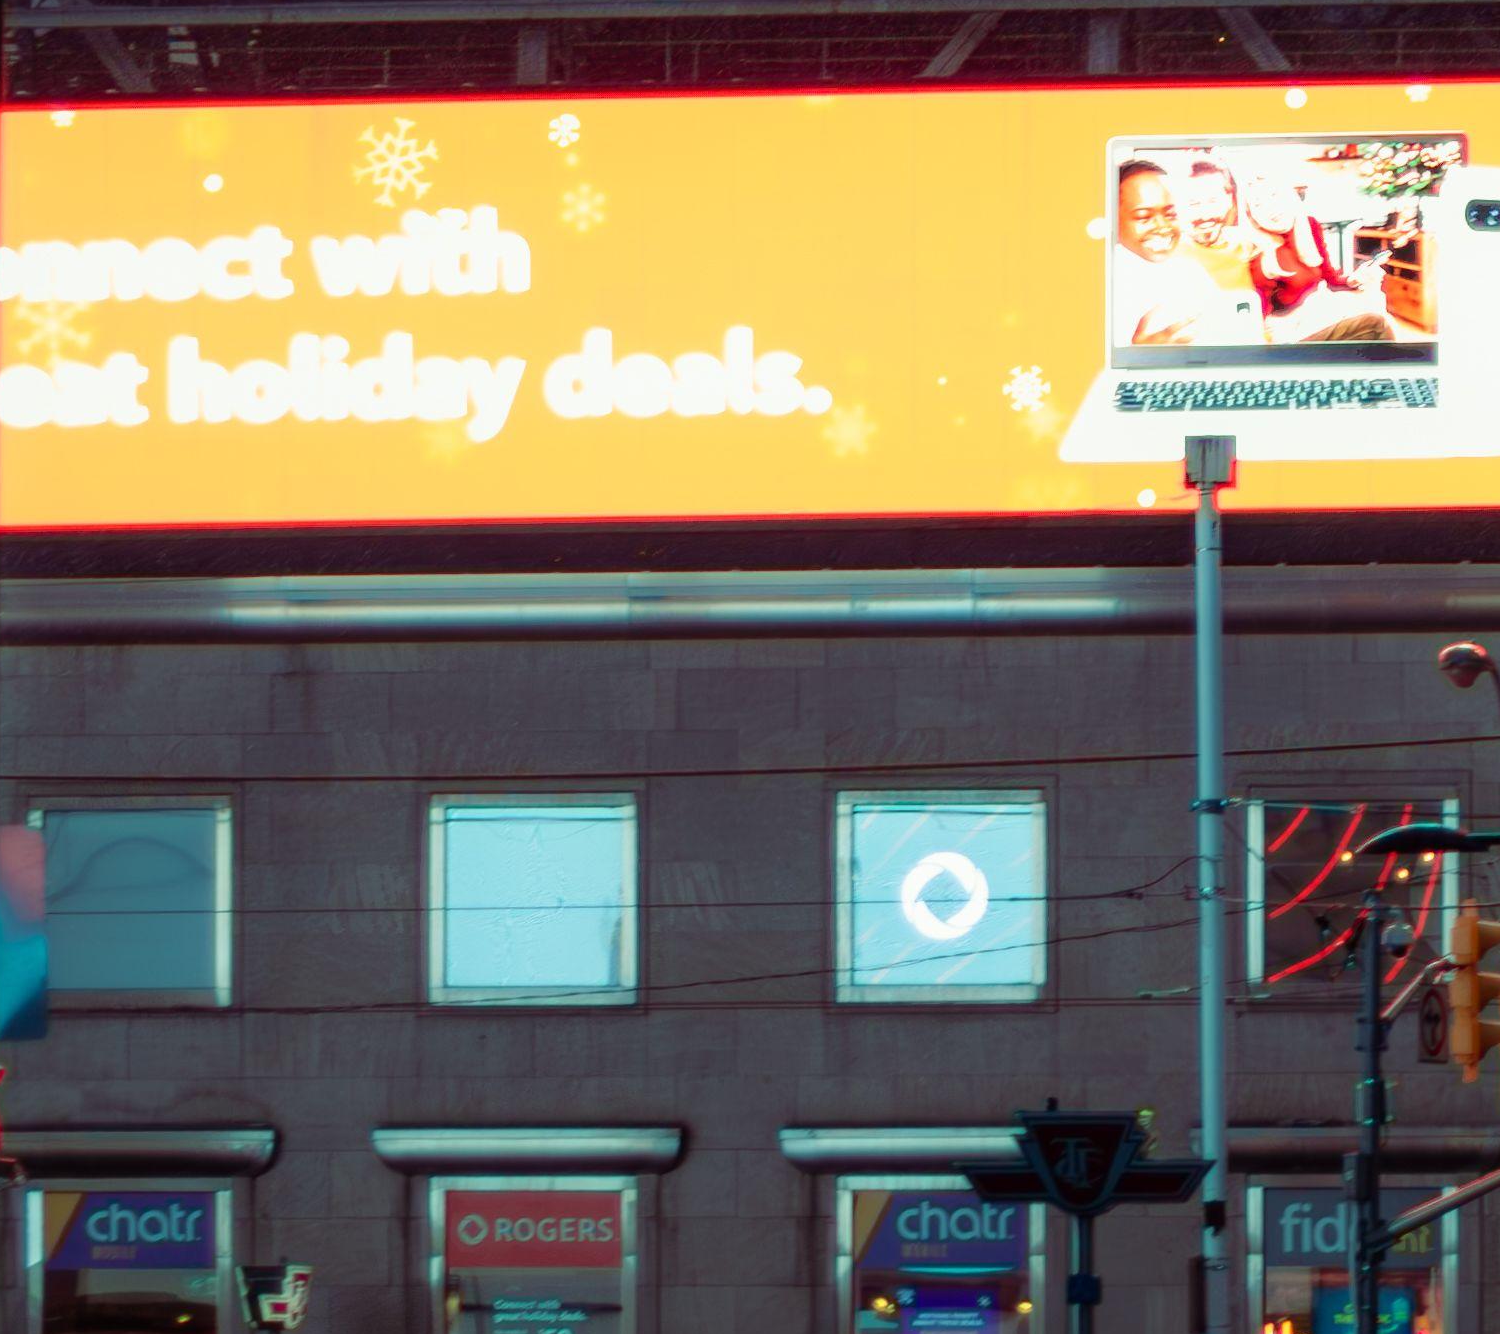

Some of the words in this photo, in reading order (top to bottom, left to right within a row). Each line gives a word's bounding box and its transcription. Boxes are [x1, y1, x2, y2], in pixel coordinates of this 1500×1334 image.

[309, 205, 531, 297] with
[167, 330, 526, 444] holiday
[542, 325, 833, 418] deals.
[85, 1202, 204, 1243] chatr
[494, 1217, 614, 1243] ROGERS
[896, 1200, 1016, 1241] chatr
